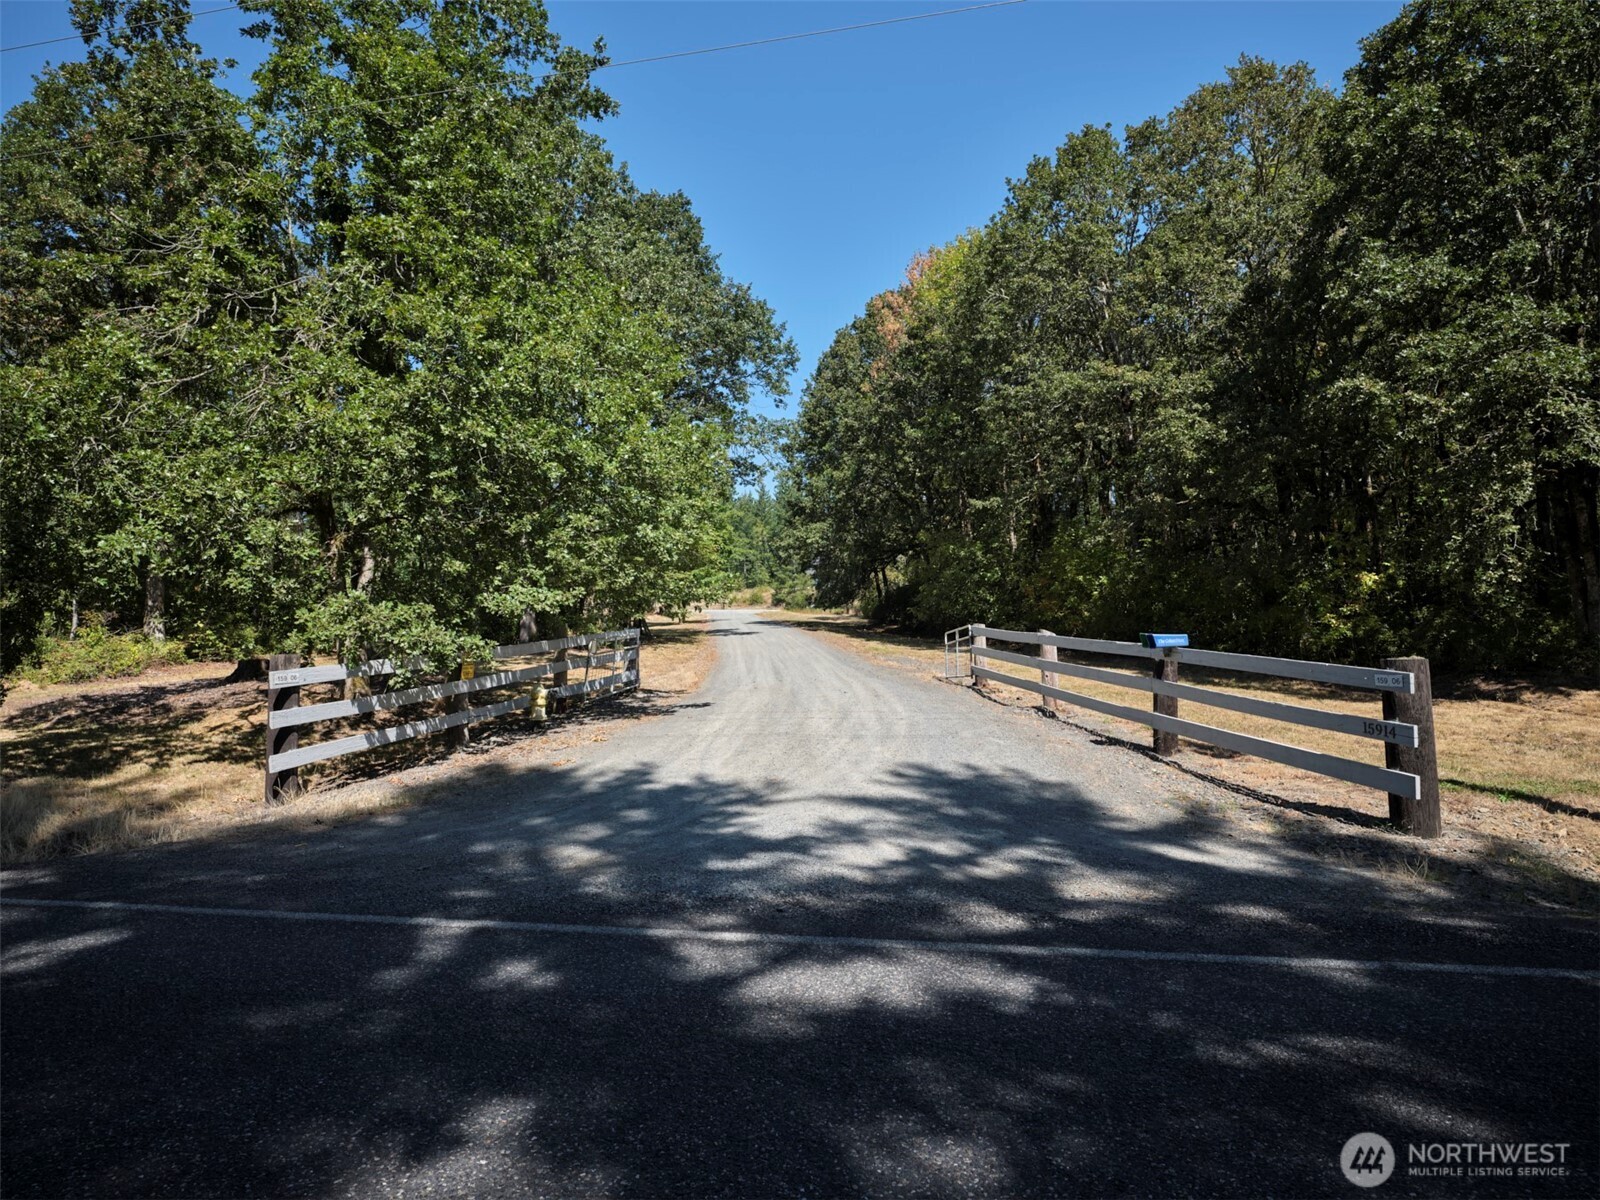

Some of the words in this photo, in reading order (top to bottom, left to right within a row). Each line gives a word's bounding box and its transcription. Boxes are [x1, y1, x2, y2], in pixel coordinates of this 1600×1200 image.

[1377, 676, 1388, 685] 159
[1391, 677, 1401, 685] 06
[1362, 721, 1396, 739] 15914
